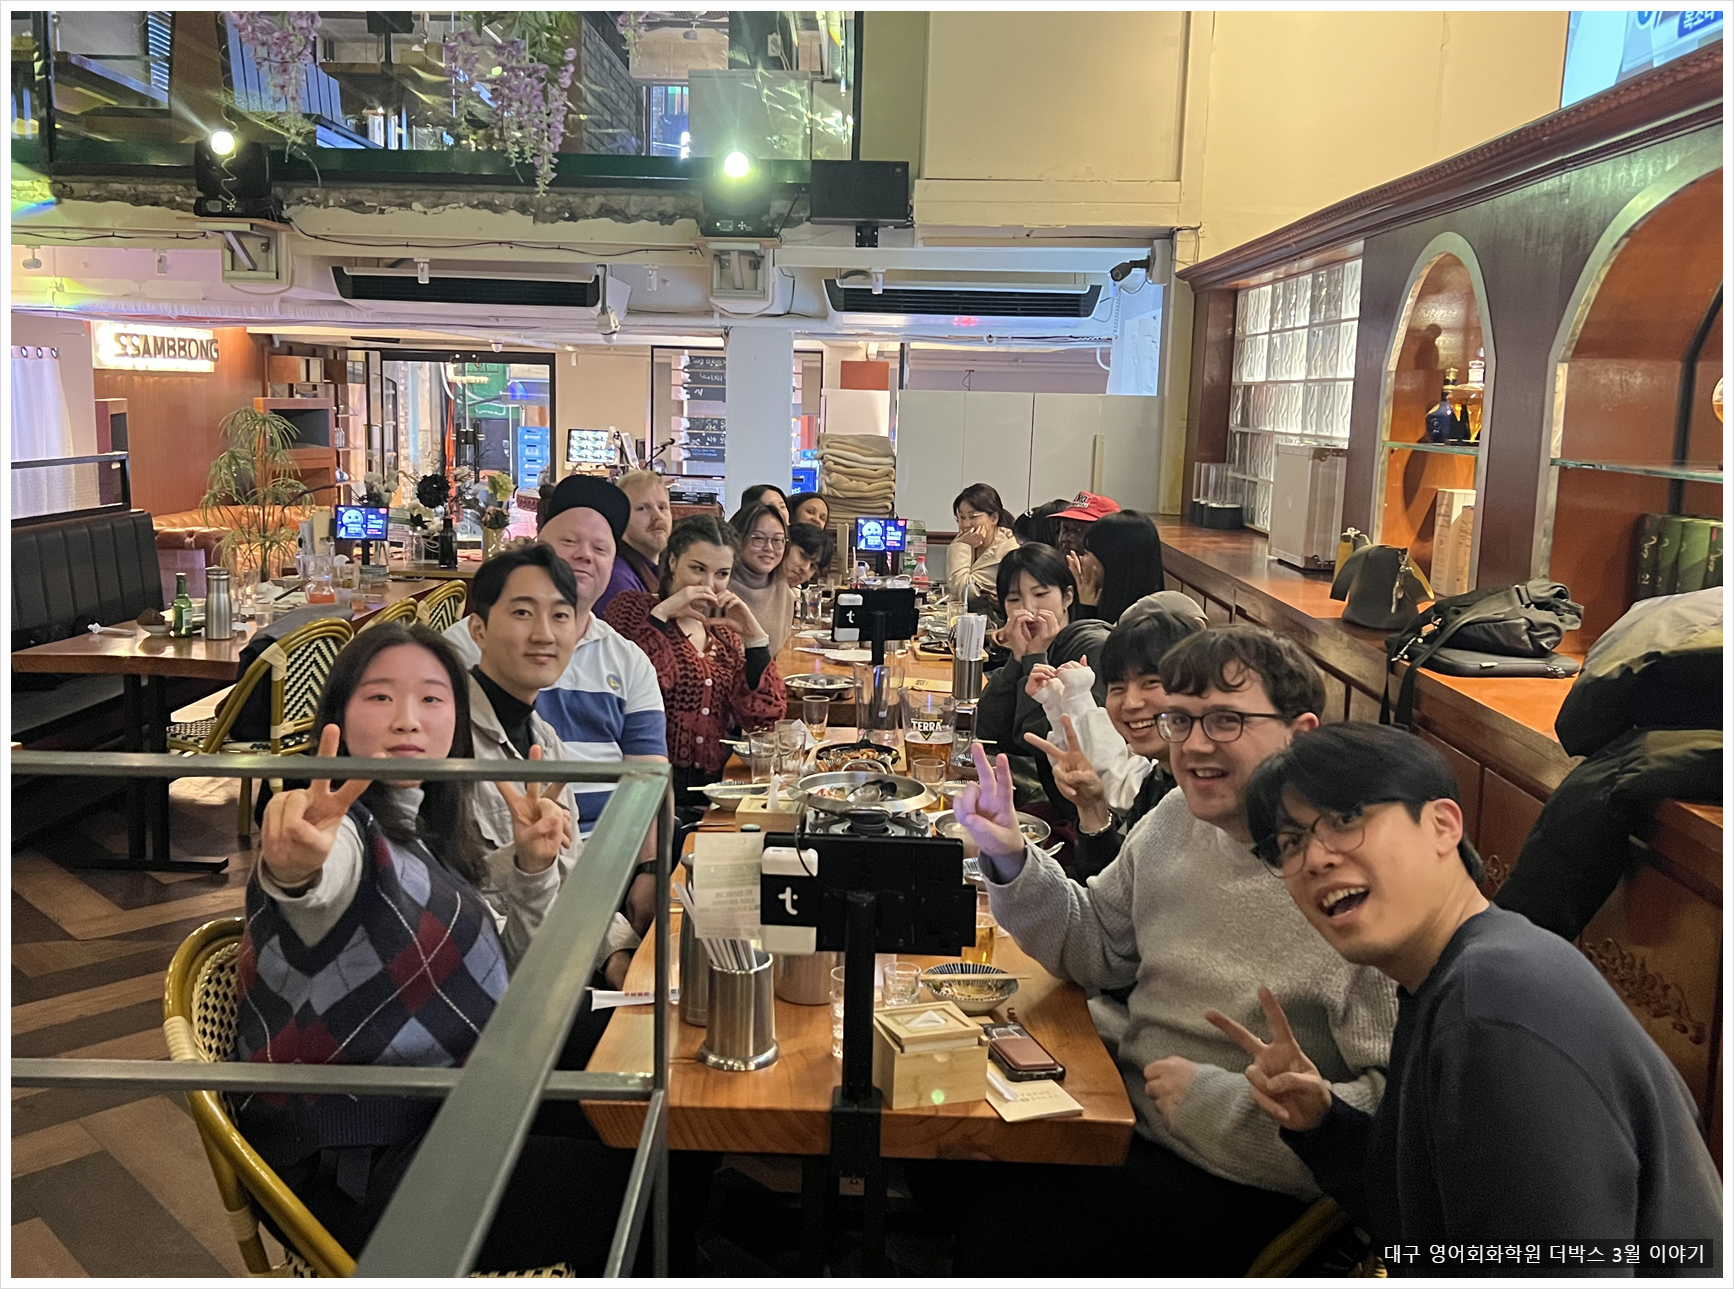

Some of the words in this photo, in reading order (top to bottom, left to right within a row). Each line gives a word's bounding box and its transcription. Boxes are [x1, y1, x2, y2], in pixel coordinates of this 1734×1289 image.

[114, 333, 219, 362] SSAMBBONG
[1641, 573, 1650, 585] 2
[911, 720, 943, 732] TERRA
